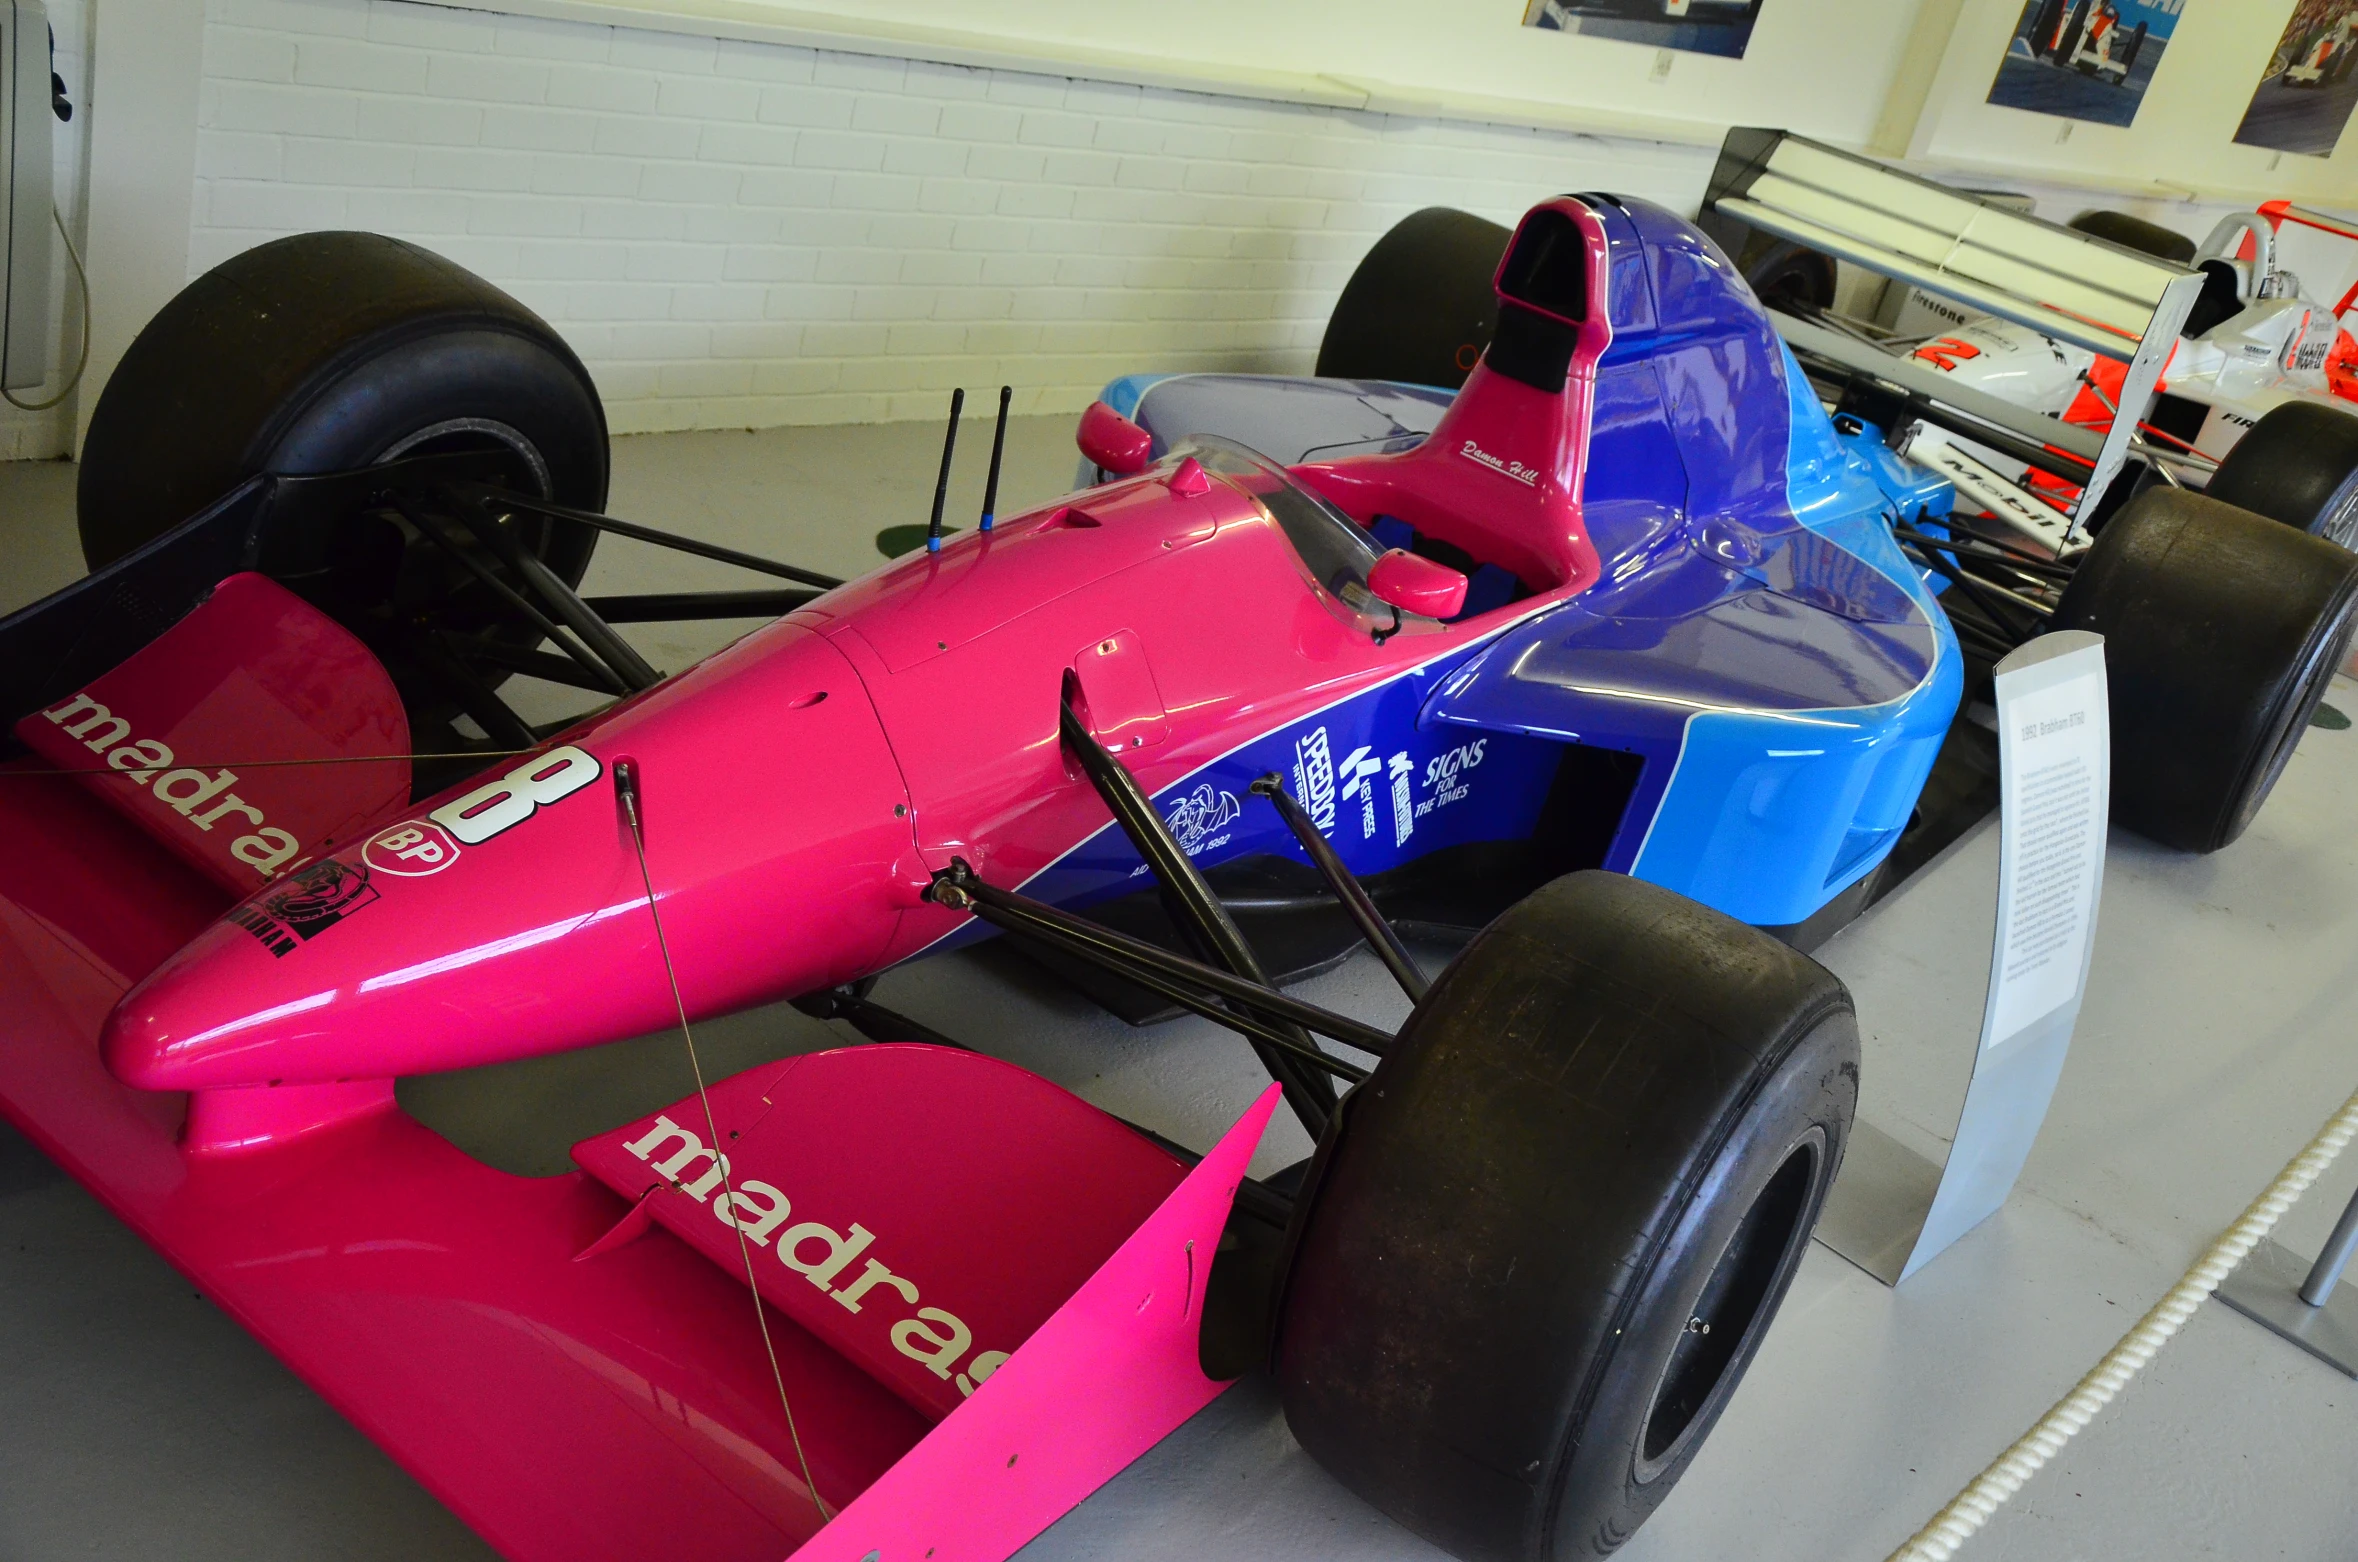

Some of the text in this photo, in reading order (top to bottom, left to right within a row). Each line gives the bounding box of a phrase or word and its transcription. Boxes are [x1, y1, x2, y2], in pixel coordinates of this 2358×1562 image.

[1914, 337, 1981, 372] 2
[1462, 440, 1539, 482] Damon Hill
[1941, 457, 2056, 528] Mobil
[2021, 723, 2038, 742] 1992
[2040, 717, 2068, 737] Brabham
[1421, 738, 1488, 787] SIGNS
[426, 744, 604, 847] 8
[1414, 783, 1470, 819] THE TIMES
[1434, 774, 1457, 795] FOR
[1360, 778, 1376, 840] KEY PRESS
[375, 827, 444, 864] BP
[1205, 833, 1231, 851] 1992
